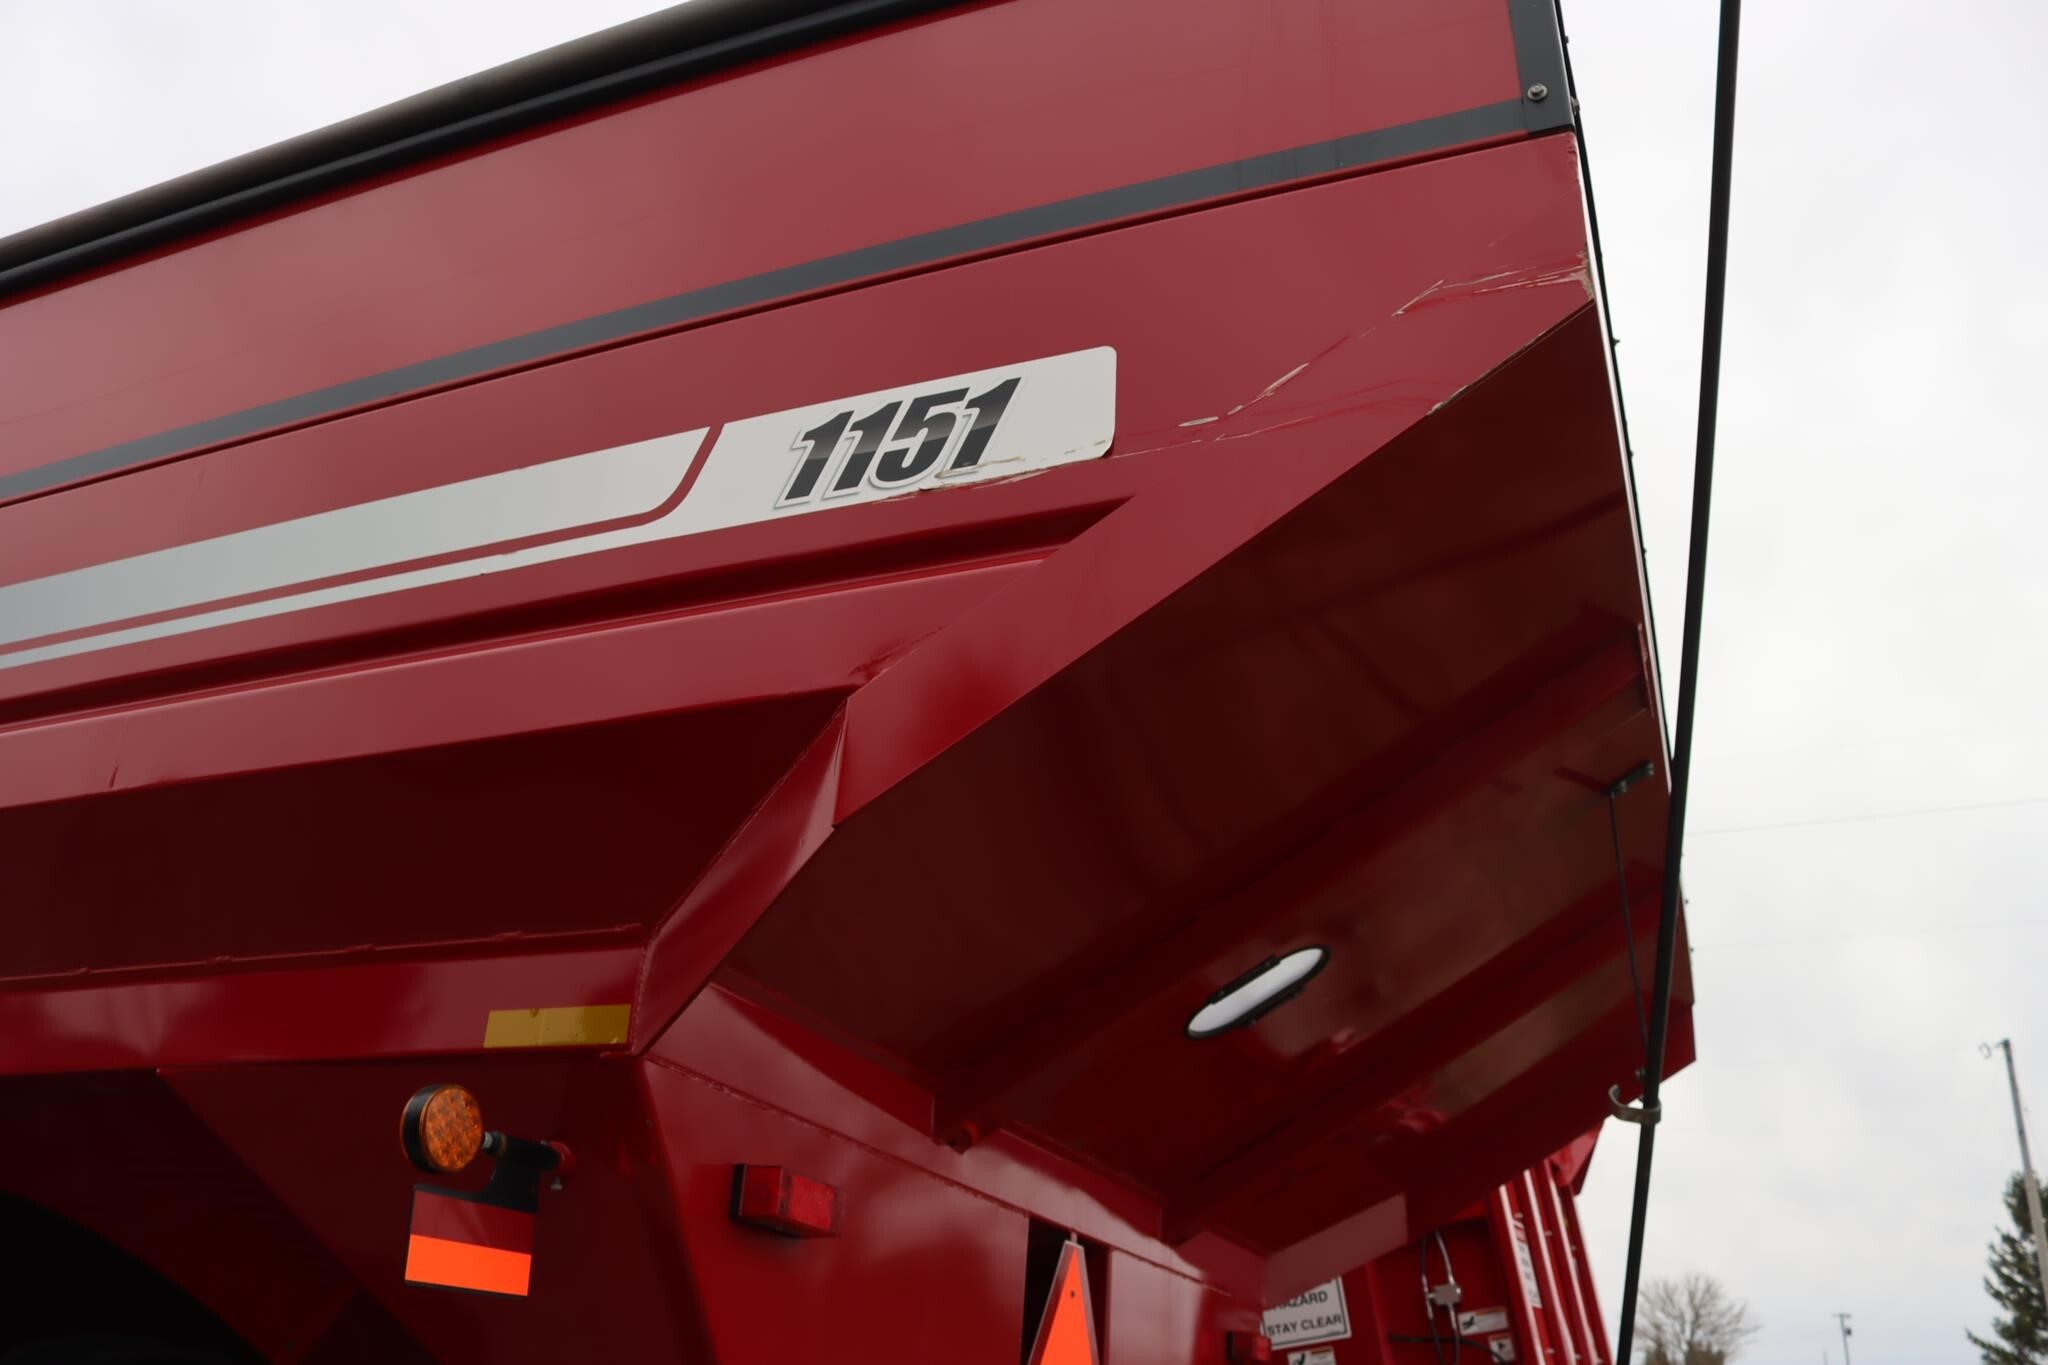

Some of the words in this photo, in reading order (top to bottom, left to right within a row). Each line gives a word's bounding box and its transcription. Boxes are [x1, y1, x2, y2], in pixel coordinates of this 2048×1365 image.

[775, 376, 1024, 507] 1151
[1267, 1321, 1297, 1336] STAY
[1300, 1314, 1341, 1331] CLEAR
